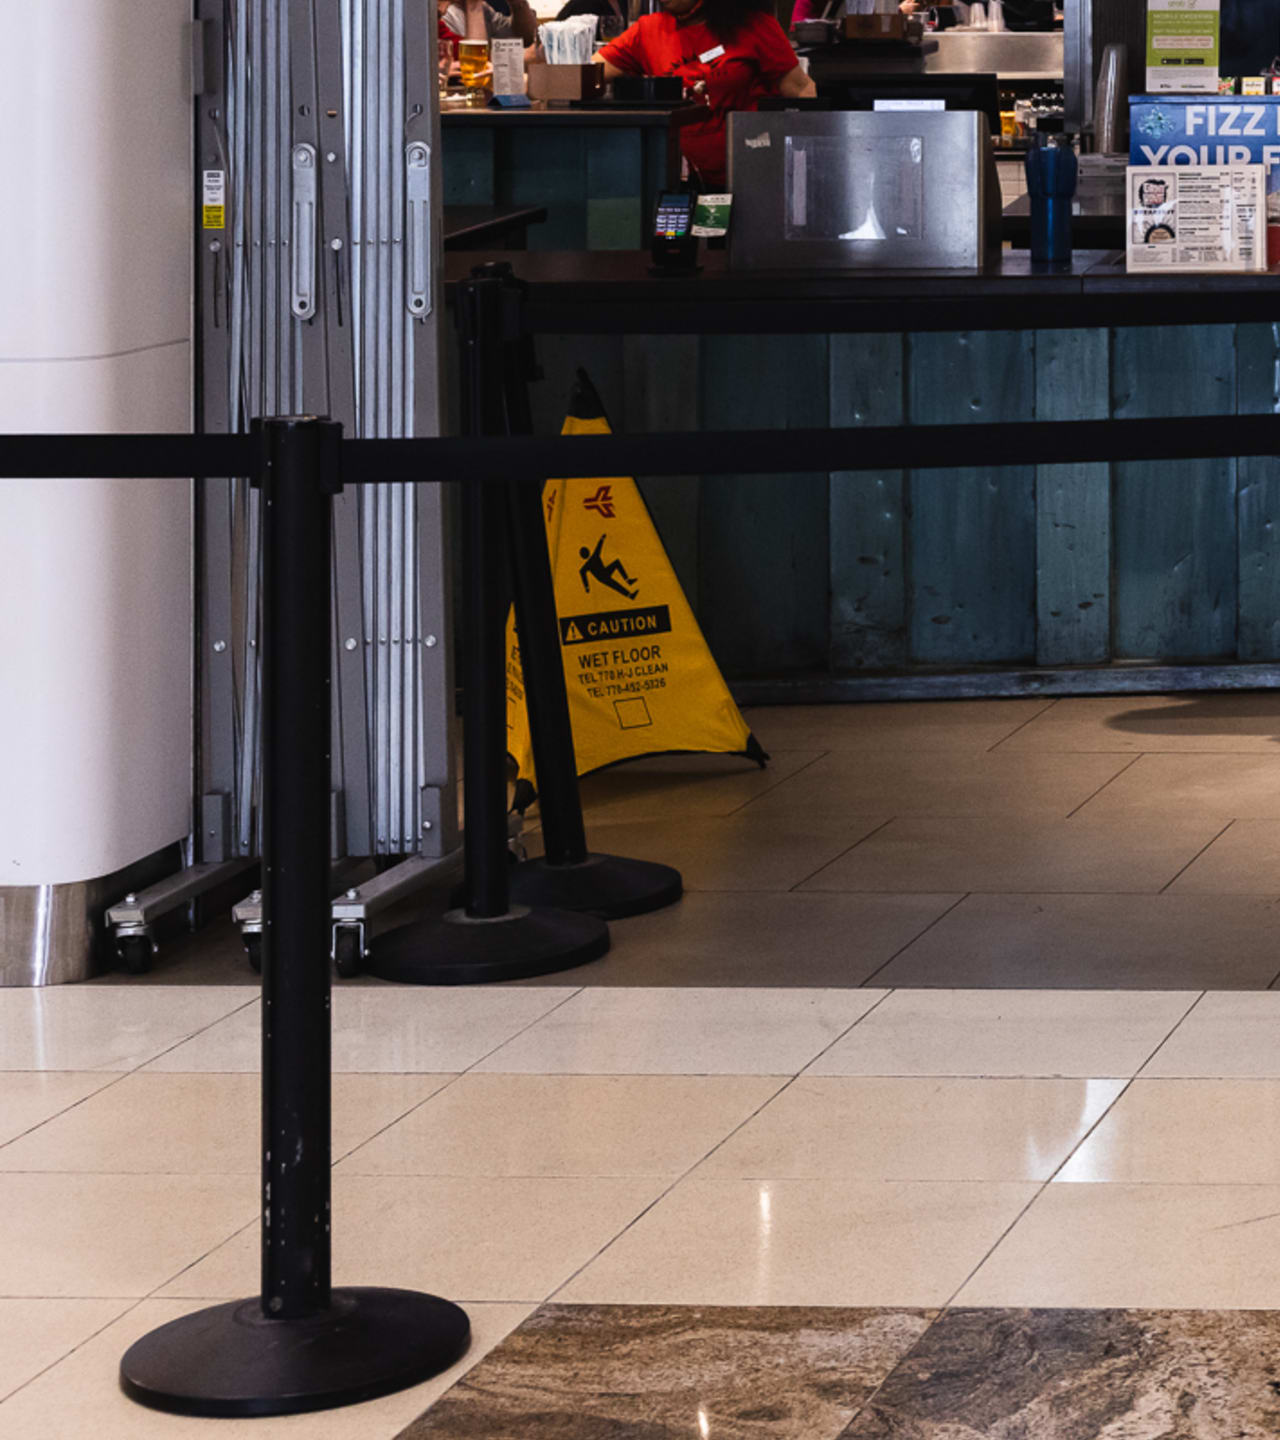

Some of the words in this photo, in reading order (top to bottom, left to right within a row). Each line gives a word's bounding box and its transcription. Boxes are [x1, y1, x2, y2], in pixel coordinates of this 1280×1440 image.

[1185, 104, 1266, 137] FIZZ
[1139, 144, 1252, 167] YOUR
[587, 614, 657, 637] CAUTION
[577, 651, 609, 670] WET
[612, 644, 662, 665] FLOOR
[634, 662, 669, 677] CLEAN
